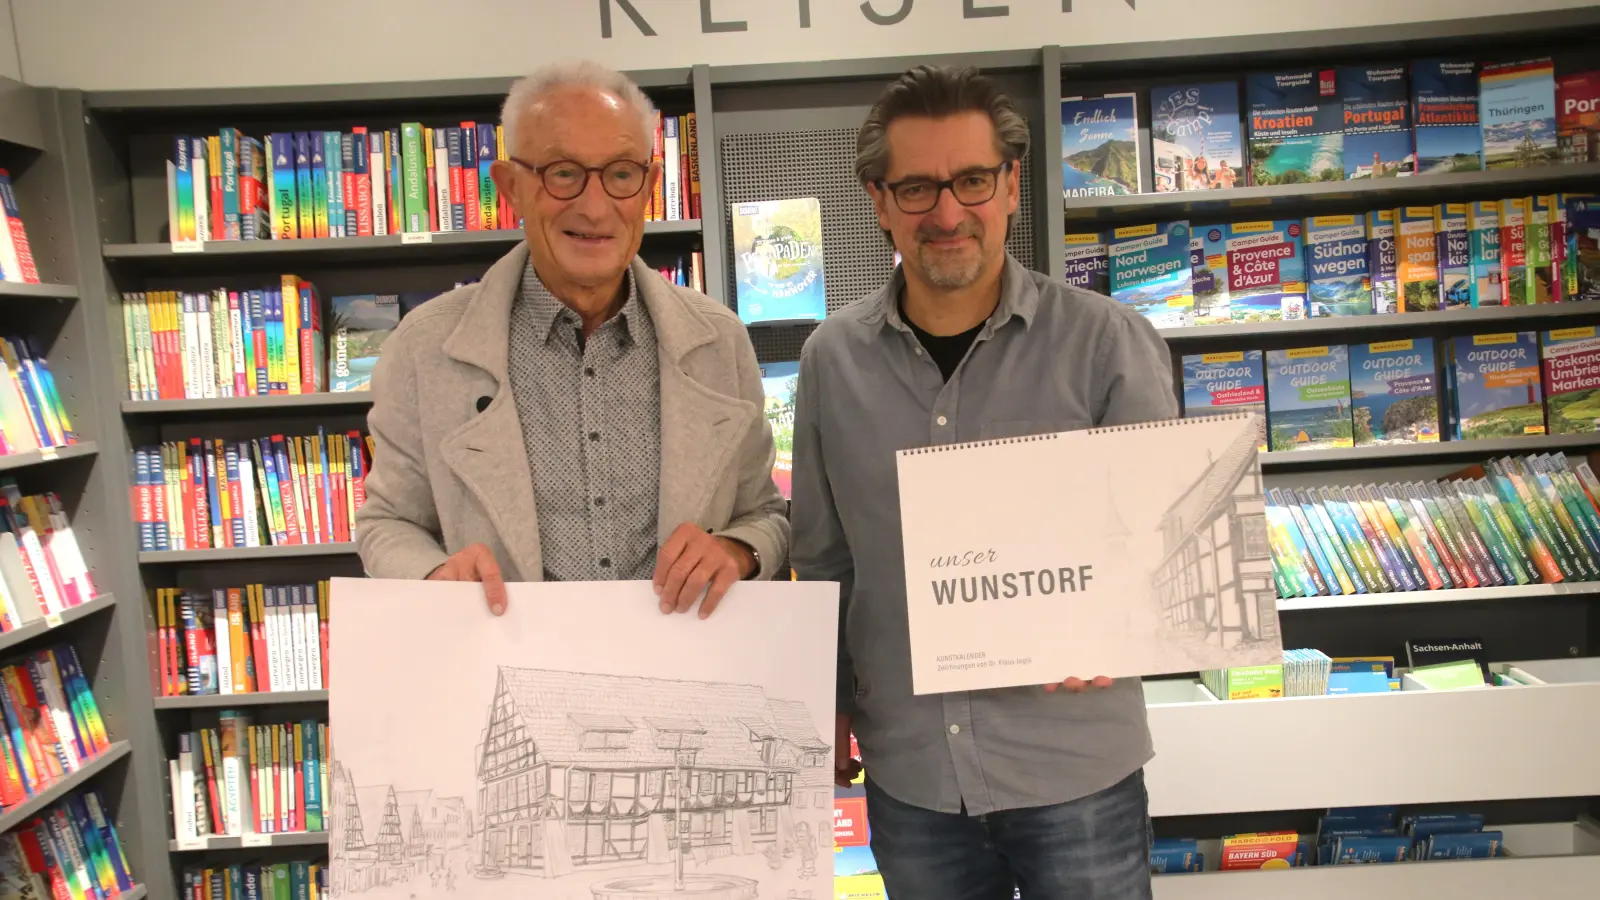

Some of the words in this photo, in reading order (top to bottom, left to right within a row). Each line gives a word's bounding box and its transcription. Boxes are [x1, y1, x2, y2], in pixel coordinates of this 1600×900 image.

[1275, 72, 1312, 82] Wohnmobil
[1366, 68, 1404, 76] Wohnmobil
[1074, 108, 1117, 126] Endlich
[1344, 106, 1404, 126] Portugal
[1488, 102, 1544, 118] Thüringen
[1253, 114, 1313, 130] Kroatien
[1078, 128, 1114, 144] Sonne
[178, 138, 188, 172] Azoren
[692, 118, 700, 182] BASKENLAND
[224, 151, 235, 192] Portugal
[409, 140, 419, 198] Andalusien
[1063, 185, 1116, 199] MADEIRA
[359, 175, 370, 234] LISSABON
[280, 188, 292, 239] Portugal
[1232, 238, 1259, 248] Camper
[1260, 234, 1280, 242] Guide
[1314, 232, 1340, 242] Camper
[1341, 228, 1360, 237] Guide
[1116, 242, 1142, 253] Camper
[1144, 237, 1163, 247] Guide
[1314, 242, 1368, 260] Südnor
[1116, 250, 1148, 268] Nord
[1232, 245, 1291, 264] Provence
[1448, 252, 1469, 266] küs
[1116, 259, 1182, 281] norwegen
[1232, 264, 1242, 275] &
[1244, 260, 1276, 273] Côte
[1313, 257, 1366, 275] wegen
[772, 270, 818, 298] HANNOVER
[1234, 273, 1274, 288] d'Azur
[336, 326, 349, 377] gomera
[1467, 348, 1527, 362] OUTDOOR
[1550, 345, 1579, 354] Camper
[1280, 361, 1338, 376] OUTDOOR
[1363, 355, 1422, 370] OUTDOOR
[1479, 361, 1516, 374] GUIDE
[1195, 366, 1252, 381] OUTDOOR
[1374, 368, 1412, 381] GUIDE
[1551, 363, 1600, 380] Umbrie
[336, 380, 347, 392] la
[1206, 379, 1242, 393] GUIDE
[1290, 374, 1327, 388] GUIDE
[1552, 377, 1600, 392] Marken
[1217, 389, 1255, 399] Ostfriesland
[217, 445, 226, 491] MALLORCA
[141, 488, 150, 520] MADRID
[155, 487, 163, 520] MADRID
[282, 481, 297, 536] MENORCA
[196, 487, 207, 542] MALLORCA
[930, 548, 998, 568] unser
[931, 564, 1093, 606] WUNSTORF
[230, 593, 240, 625] ISLAND
[189, 634, 198, 663] ISLAND
[1413, 642, 1482, 652] Sachsen-Anhalt
[937, 652, 986, 662] KUNSTKALENDER
[937, 662, 976, 671] Zeichnungen
[834, 819, 852, 827] AND
[1228, 851, 1260, 860] BAYERN
[1261, 850, 1277, 858] SÜD
